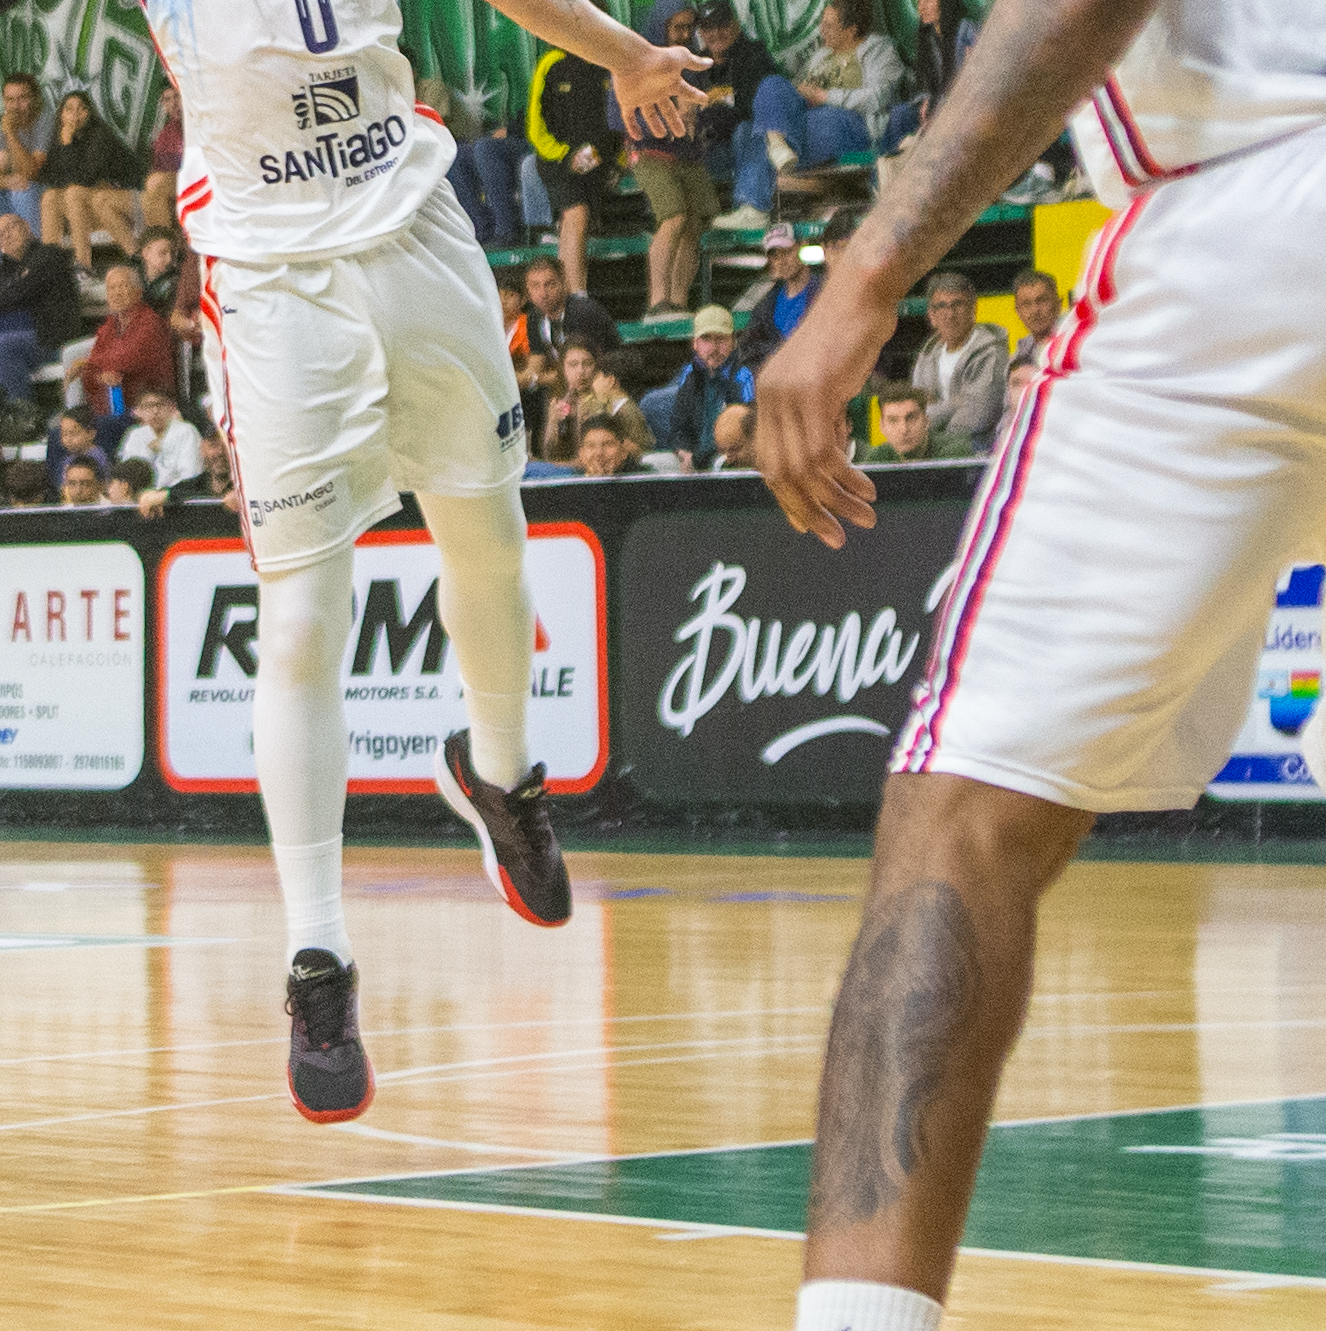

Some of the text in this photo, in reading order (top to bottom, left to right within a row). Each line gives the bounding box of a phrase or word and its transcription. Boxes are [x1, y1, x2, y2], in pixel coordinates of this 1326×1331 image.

[291, 86, 312, 130] SOL
[264, 481, 334, 513] SANTIAGO
[660, 562, 919, 737] Buena
[345, 686, 412, 701] MOTORS
